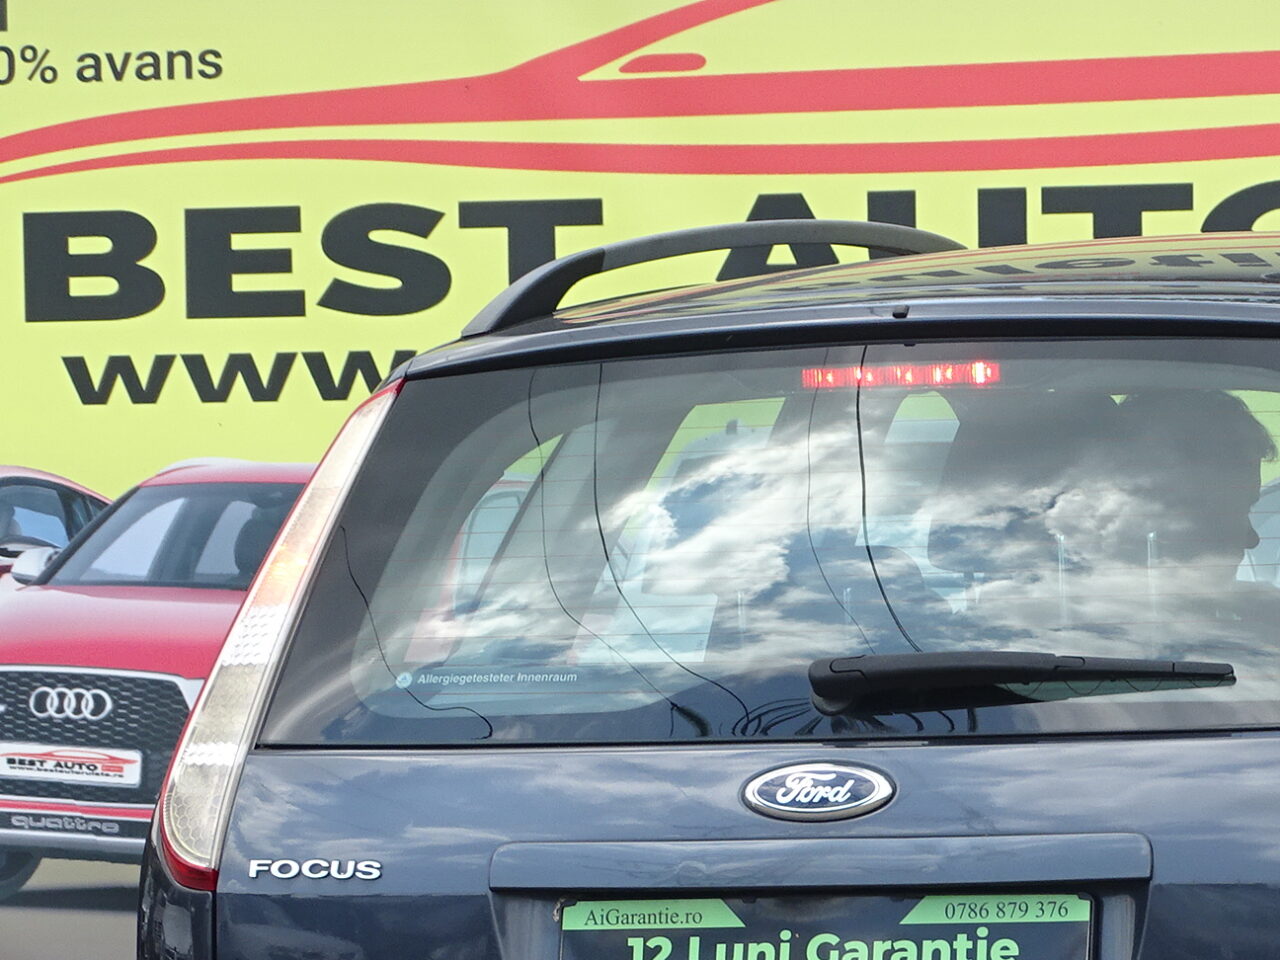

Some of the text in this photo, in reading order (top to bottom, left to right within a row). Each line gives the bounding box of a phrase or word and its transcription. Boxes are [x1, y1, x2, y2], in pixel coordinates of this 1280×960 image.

[76, 49, 223, 83] avans
[23, 199, 603, 323] BEST
[417, 671, 578, 687] Allergiegetesteter Innenraum
[53, 760, 99, 772] AUTO
[776, 772, 855, 804] Ford
[11, 815, 120, 834] quattro
[248, 859, 382, 881] FOCUS
[584, 907, 703, 927] AiGarantie.ro
[943, 900, 1069, 921] 0786 879 376
